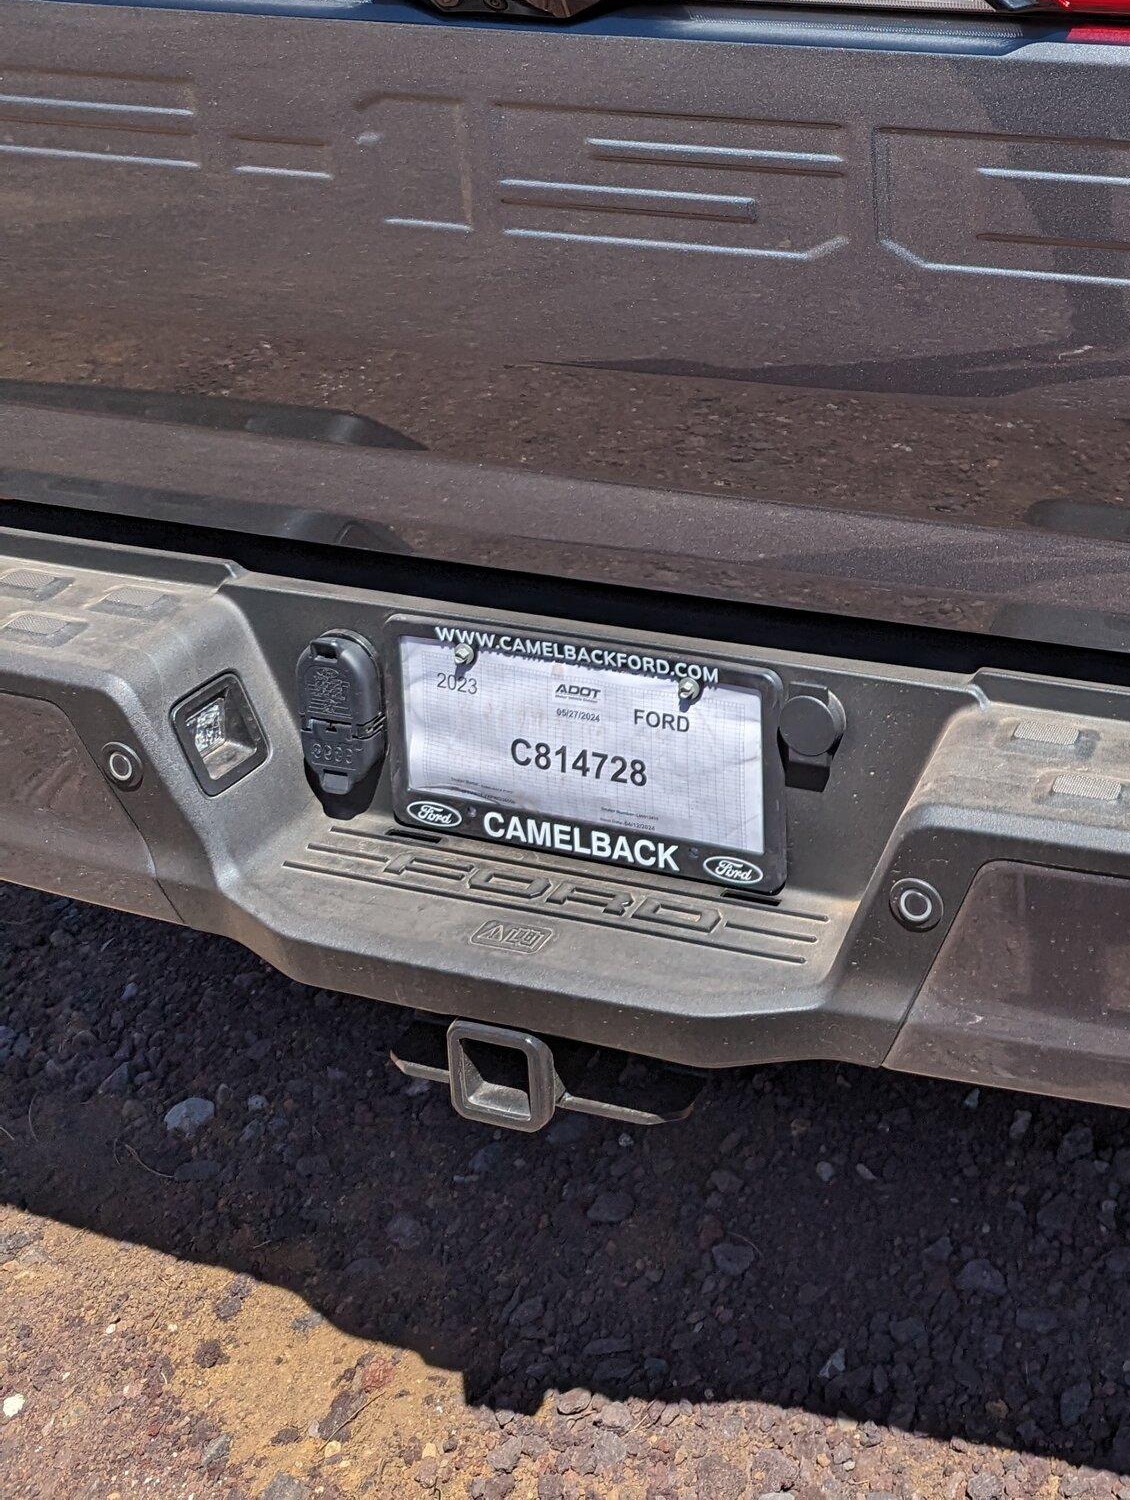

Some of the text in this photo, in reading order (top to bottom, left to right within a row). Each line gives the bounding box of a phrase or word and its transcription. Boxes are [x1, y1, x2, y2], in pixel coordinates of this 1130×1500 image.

[434, 626, 720, 684] WWW.CAMELBACKFORD.COM
[437, 672, 479, 695] 2023
[555, 683, 601, 699] ADOT
[556, 708, 600, 723] 05/27/2024
[634, 708, 690, 733] FORD
[511, 737, 648, 787] C814728
[483, 811, 680, 872] CAMELBACK
[384, 855, 722, 933] FORD
